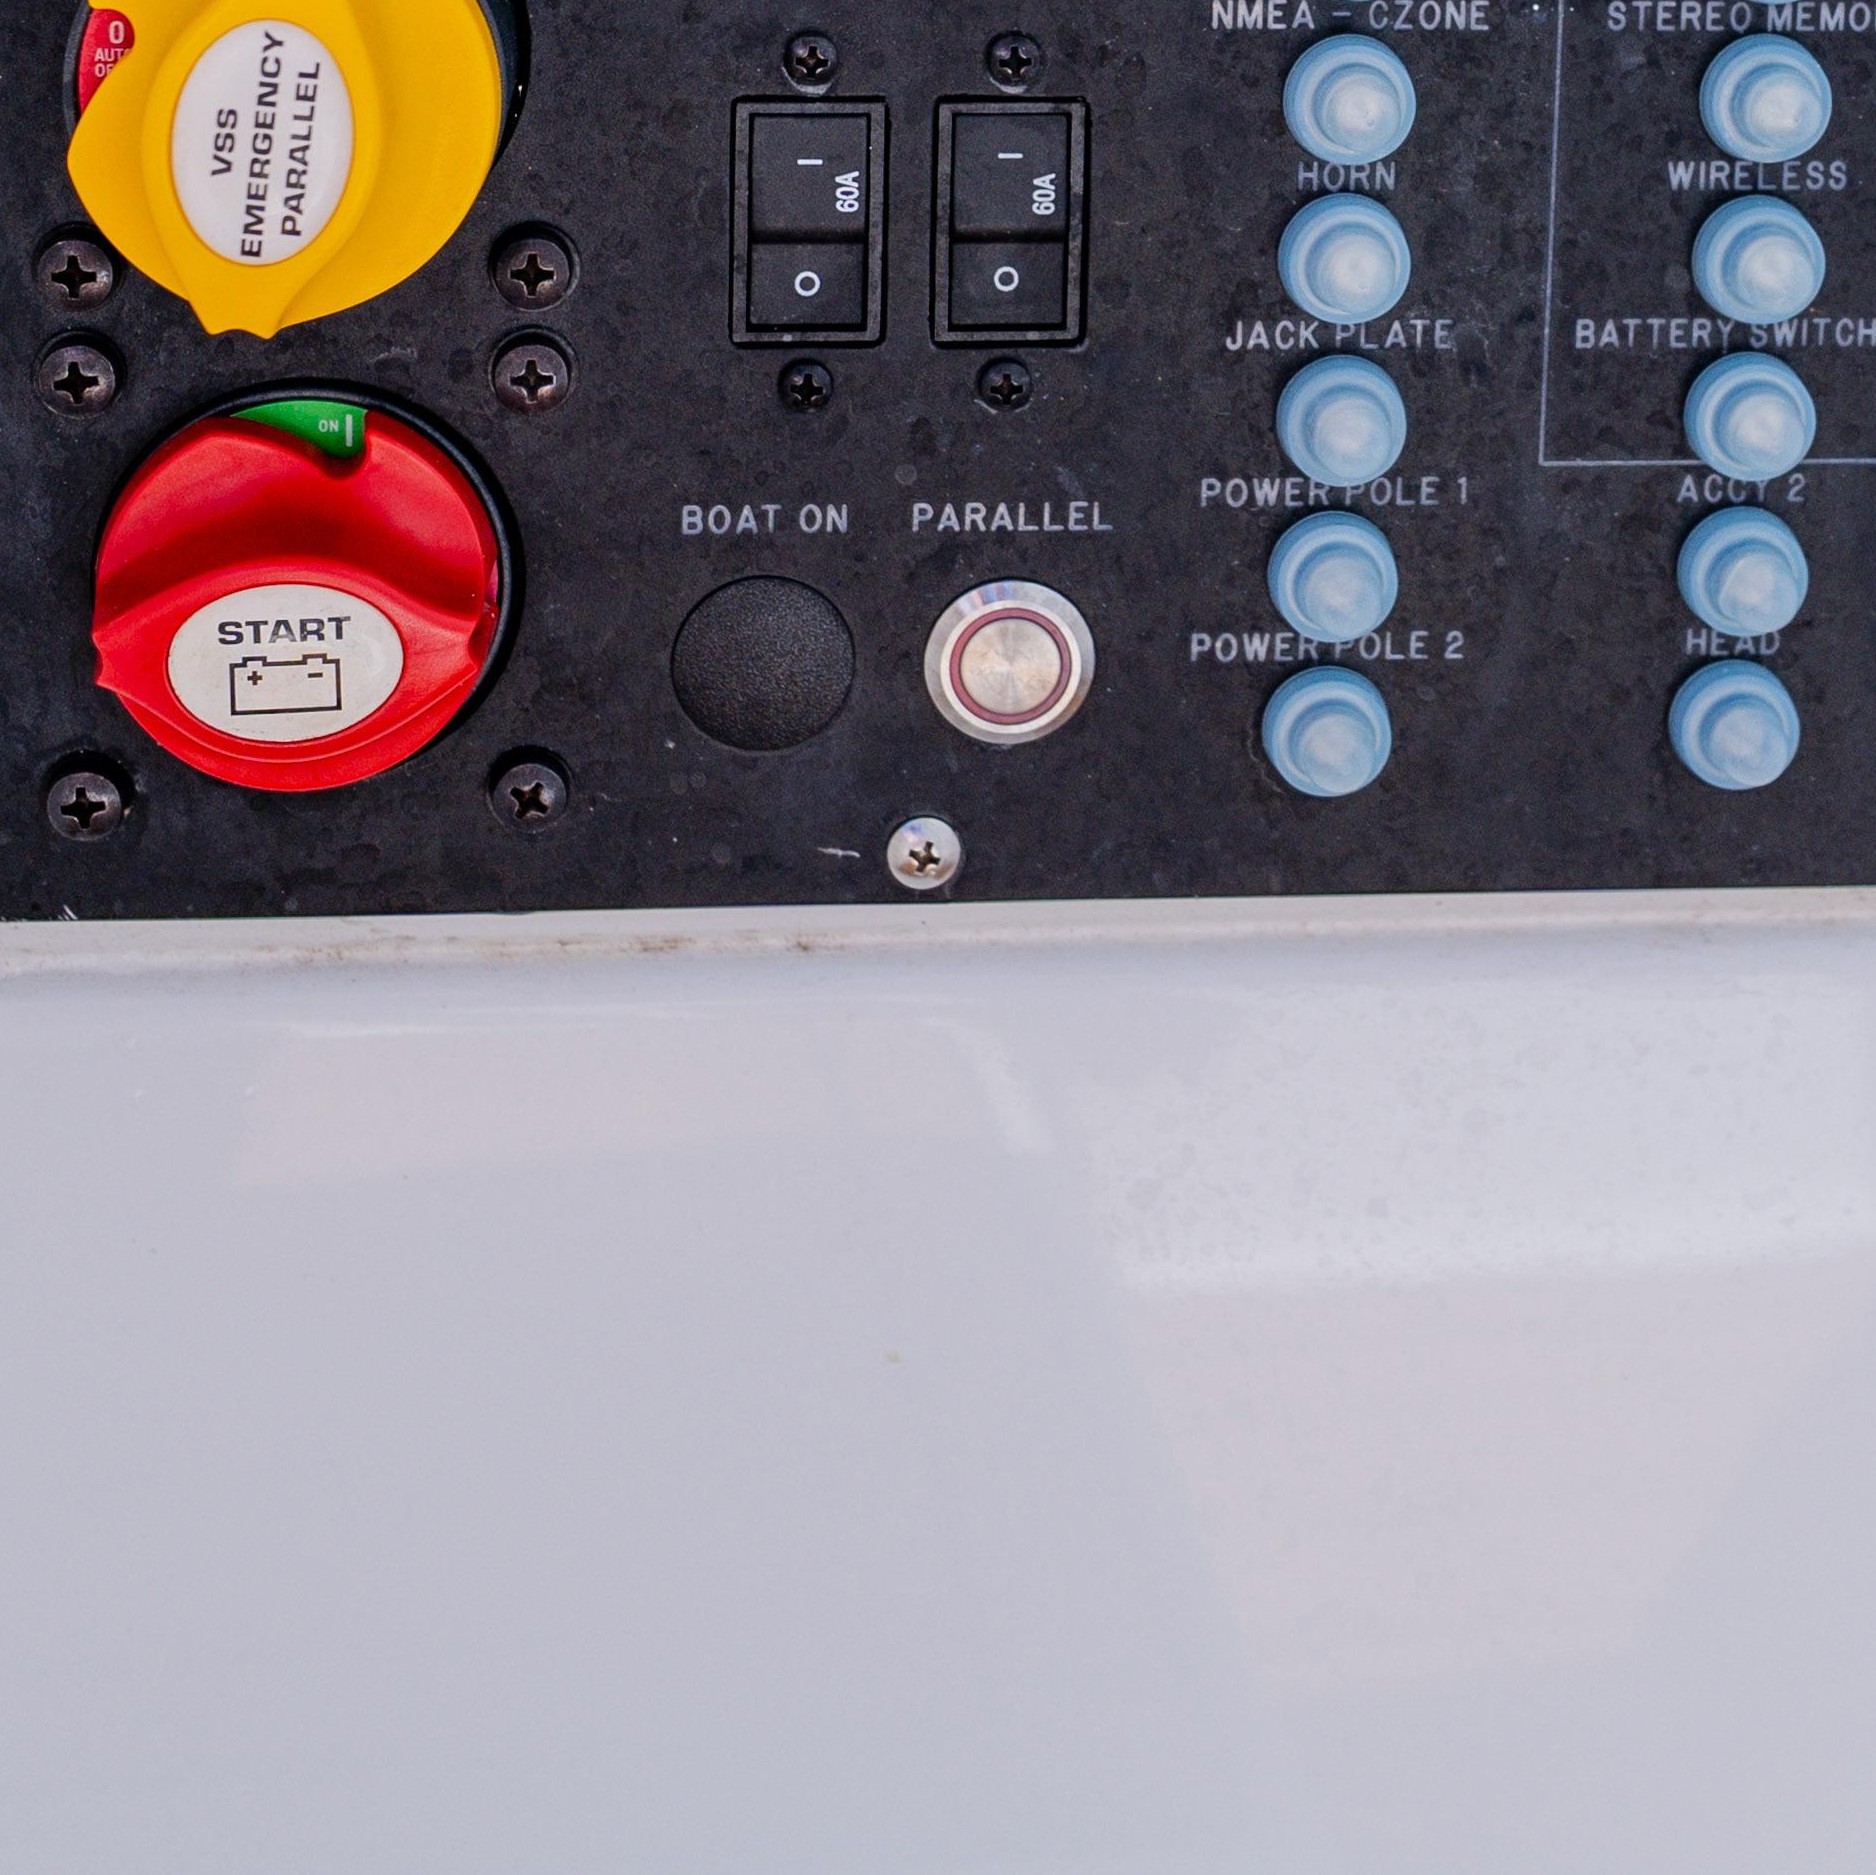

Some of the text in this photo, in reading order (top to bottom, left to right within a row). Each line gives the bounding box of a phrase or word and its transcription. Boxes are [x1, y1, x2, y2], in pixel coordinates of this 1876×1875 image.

[1368, 0, 1490, 31] CZONE
[1607, 0, 1752, 33] STEREO
[210, 107, 238, 177] VSS
[242, 31, 285, 257] EMERGENCY
[280, 61, 321, 237] PARALLEL
[1297, 161, 1396, 191] HORN
[1668, 160, 1848, 191] WIRELESS
[835, 171, 860, 213] 60A
[1032, 173, 1056, 215] 60A
[1225, 319, 1455, 350] JACK PLATE
[1575, 318, 1736, 349] BATTERY
[318, 419, 340, 433] ON
[1200, 476, 1469, 508] POWER POLE 1
[1786, 473, 1806, 503] 2
[681, 503, 848, 535] BOAT ON
[911, 501, 1114, 532] PARALLEL
[217, 616, 352, 646] START
[1190, 631, 1465, 662] POWER POLE 2
[1685, 628, 1781, 656] HEAD
